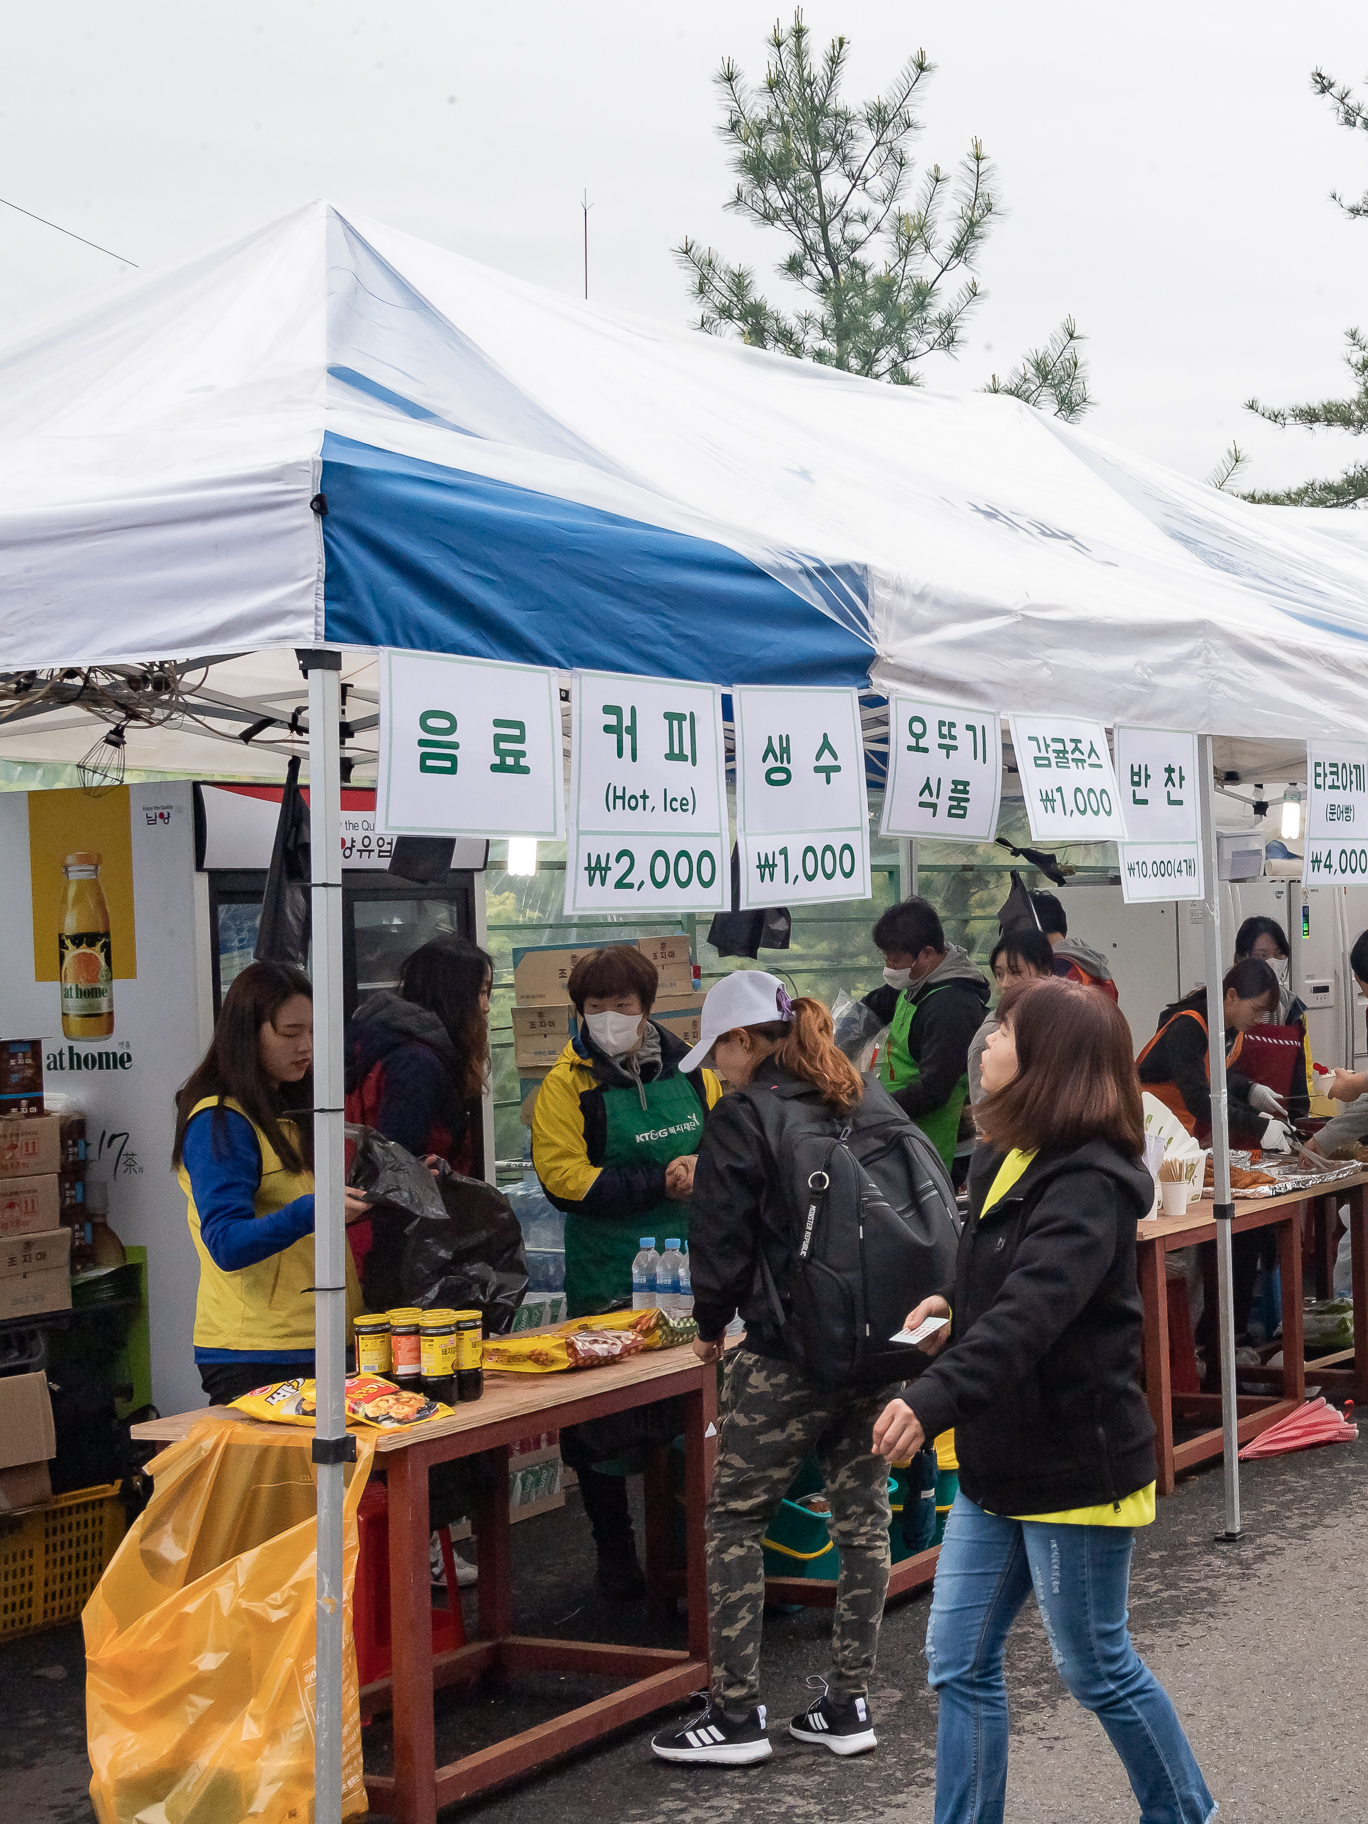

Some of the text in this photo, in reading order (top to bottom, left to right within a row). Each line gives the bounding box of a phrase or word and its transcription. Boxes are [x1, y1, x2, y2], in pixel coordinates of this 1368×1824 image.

[417, 709, 531, 775] 음료
[602, 704, 697, 767] 커피
[906, 715, 987, 765] 오뚜기
[1027, 735, 1103, 770] 감귤쥬스
[761, 733, 842, 787] 생수
[1313, 760, 1366, 793] 타코야끼
[605, 783, 697, 816] (Hot, Ice)
[918, 776, 971, 820] 식품
[1039, 785, 1112, 818] ₩1,000
[1130, 763, 1186, 806] 반찬
[345, 819, 360, 832] the
[1324, 801, 1355, 823] (문어빵)
[583, 848, 717, 892] ₩2,000
[755, 843, 856, 886] ₩1,000
[1127, 858, 1196, 879] ₩10,000(4개)
[1310, 848, 1368, 876] ₩4,000
[75, 983, 108, 999] home
[635, 1128, 668, 1143] KT&G
